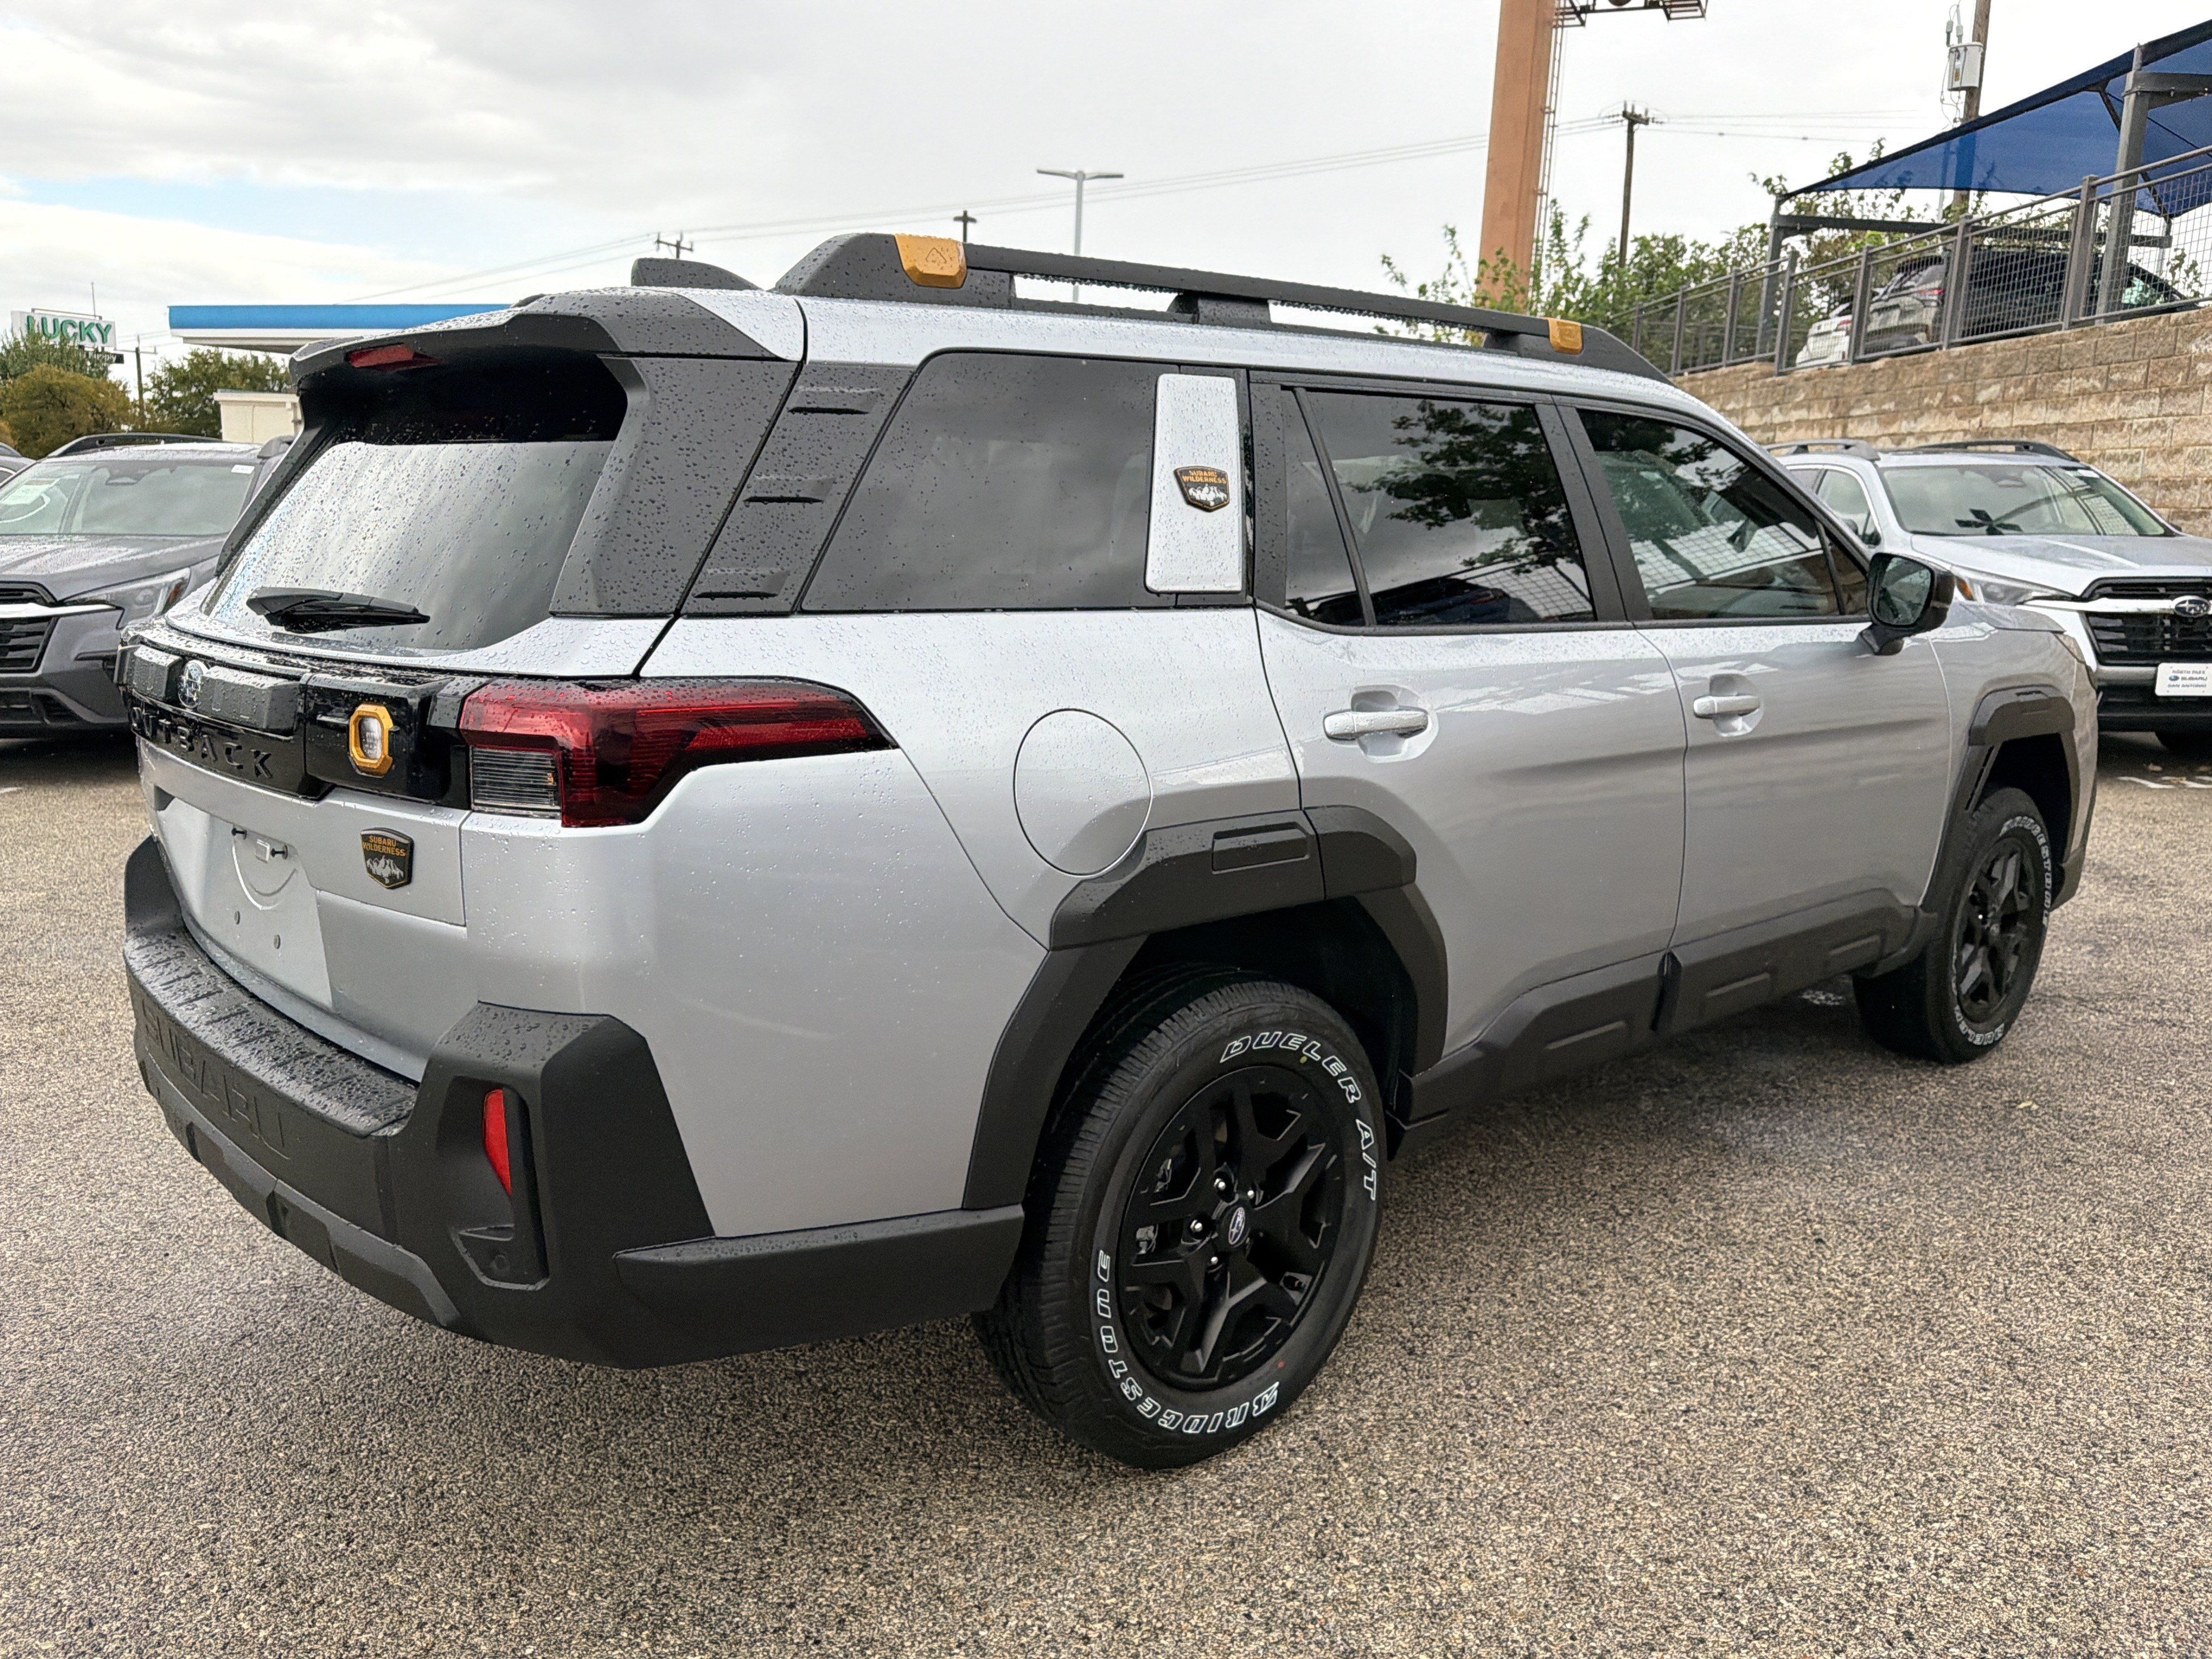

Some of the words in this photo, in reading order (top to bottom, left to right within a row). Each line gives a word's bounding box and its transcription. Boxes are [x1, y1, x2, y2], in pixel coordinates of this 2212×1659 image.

[1182, 475, 1227, 484] WILDERNESS
[362, 841, 407, 856] WILDERNESS
[369, 835, 397, 847] SUBARU
[1219, 1030, 1362, 1104] DUELER
[1355, 1118, 1377, 1201] A/T
[1097, 1249, 1280, 1434] BRIDGESTONE
